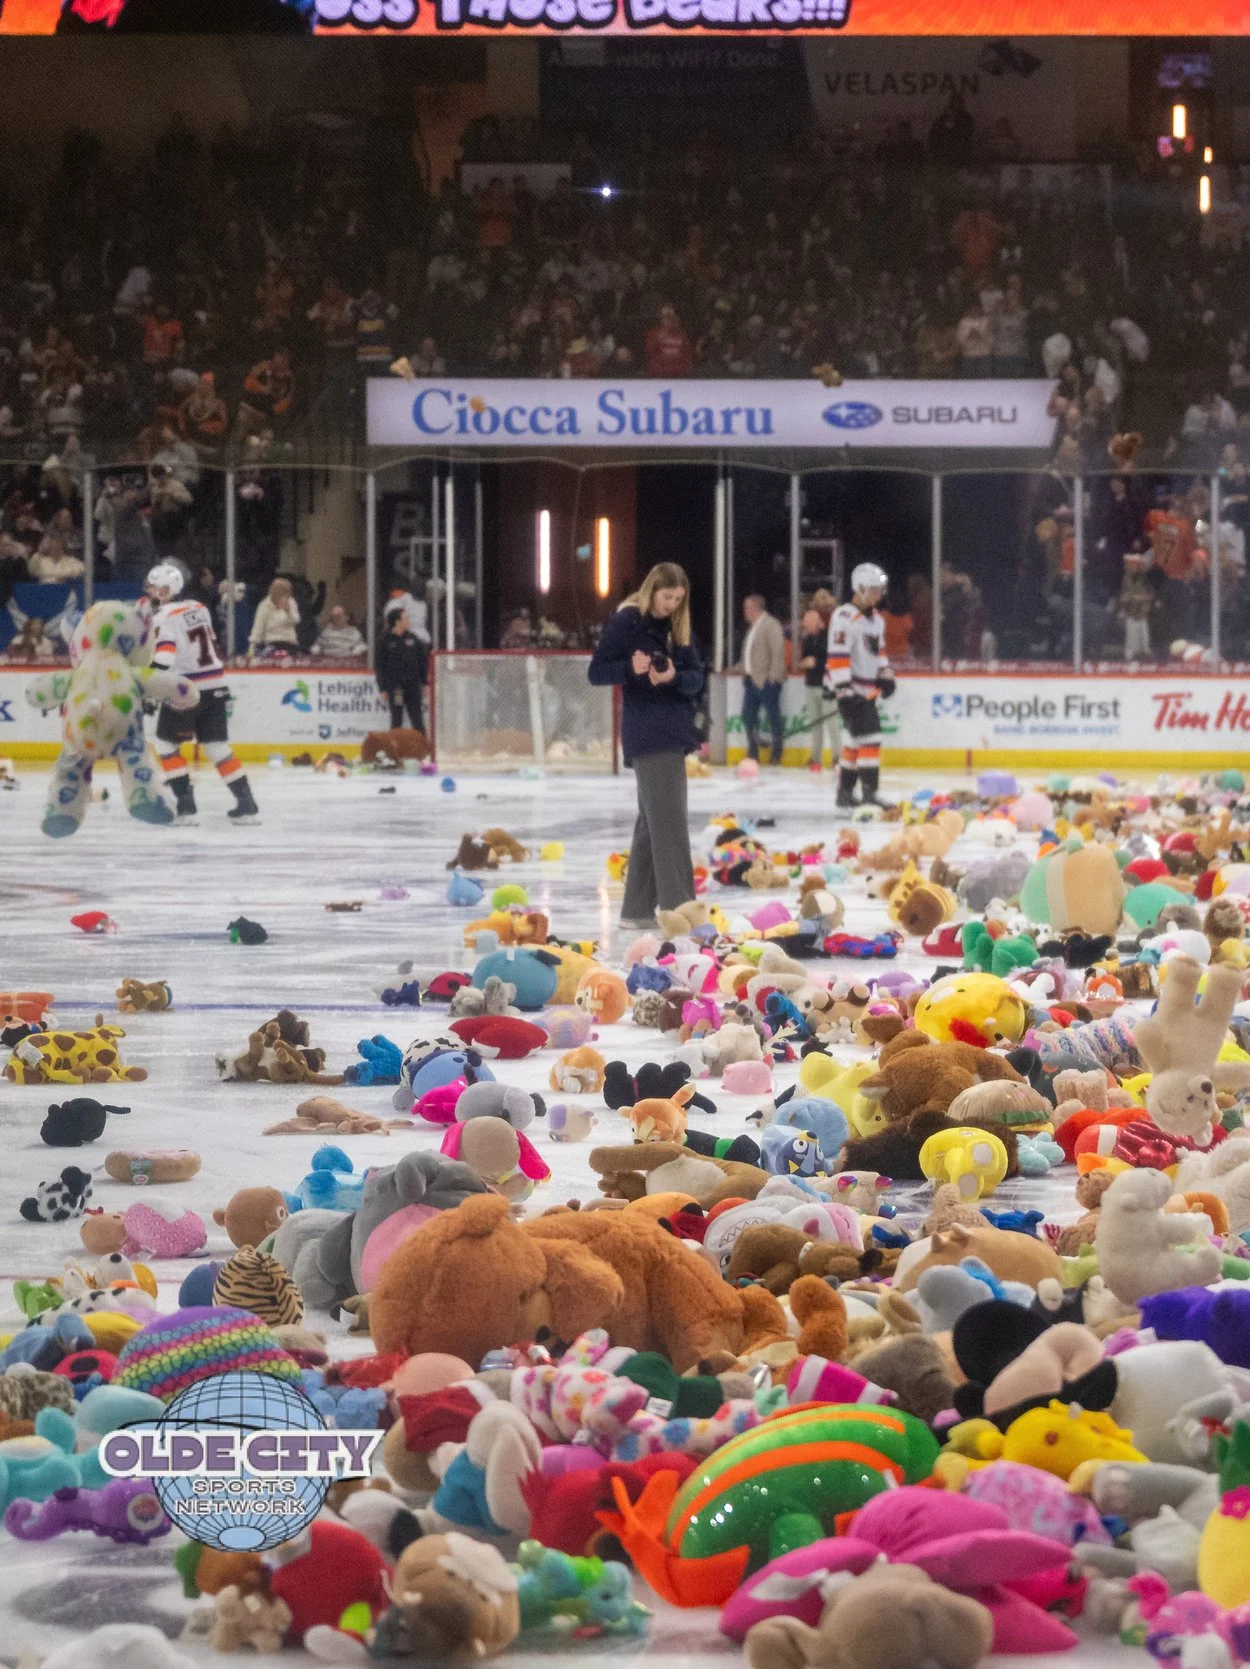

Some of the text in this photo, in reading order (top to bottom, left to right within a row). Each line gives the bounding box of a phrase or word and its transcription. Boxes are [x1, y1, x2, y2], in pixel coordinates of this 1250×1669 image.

[824, 71, 980, 96] VELASPAN
[411, 387, 775, 436] Ciocca Subaru
[891, 405, 1018, 425] SUBARU
[317, 680, 374, 697] Lehigh
[317, 697, 374, 713] Health
[965, 693, 1121, 723] People First
[1151, 691, 1210, 731] Tim
